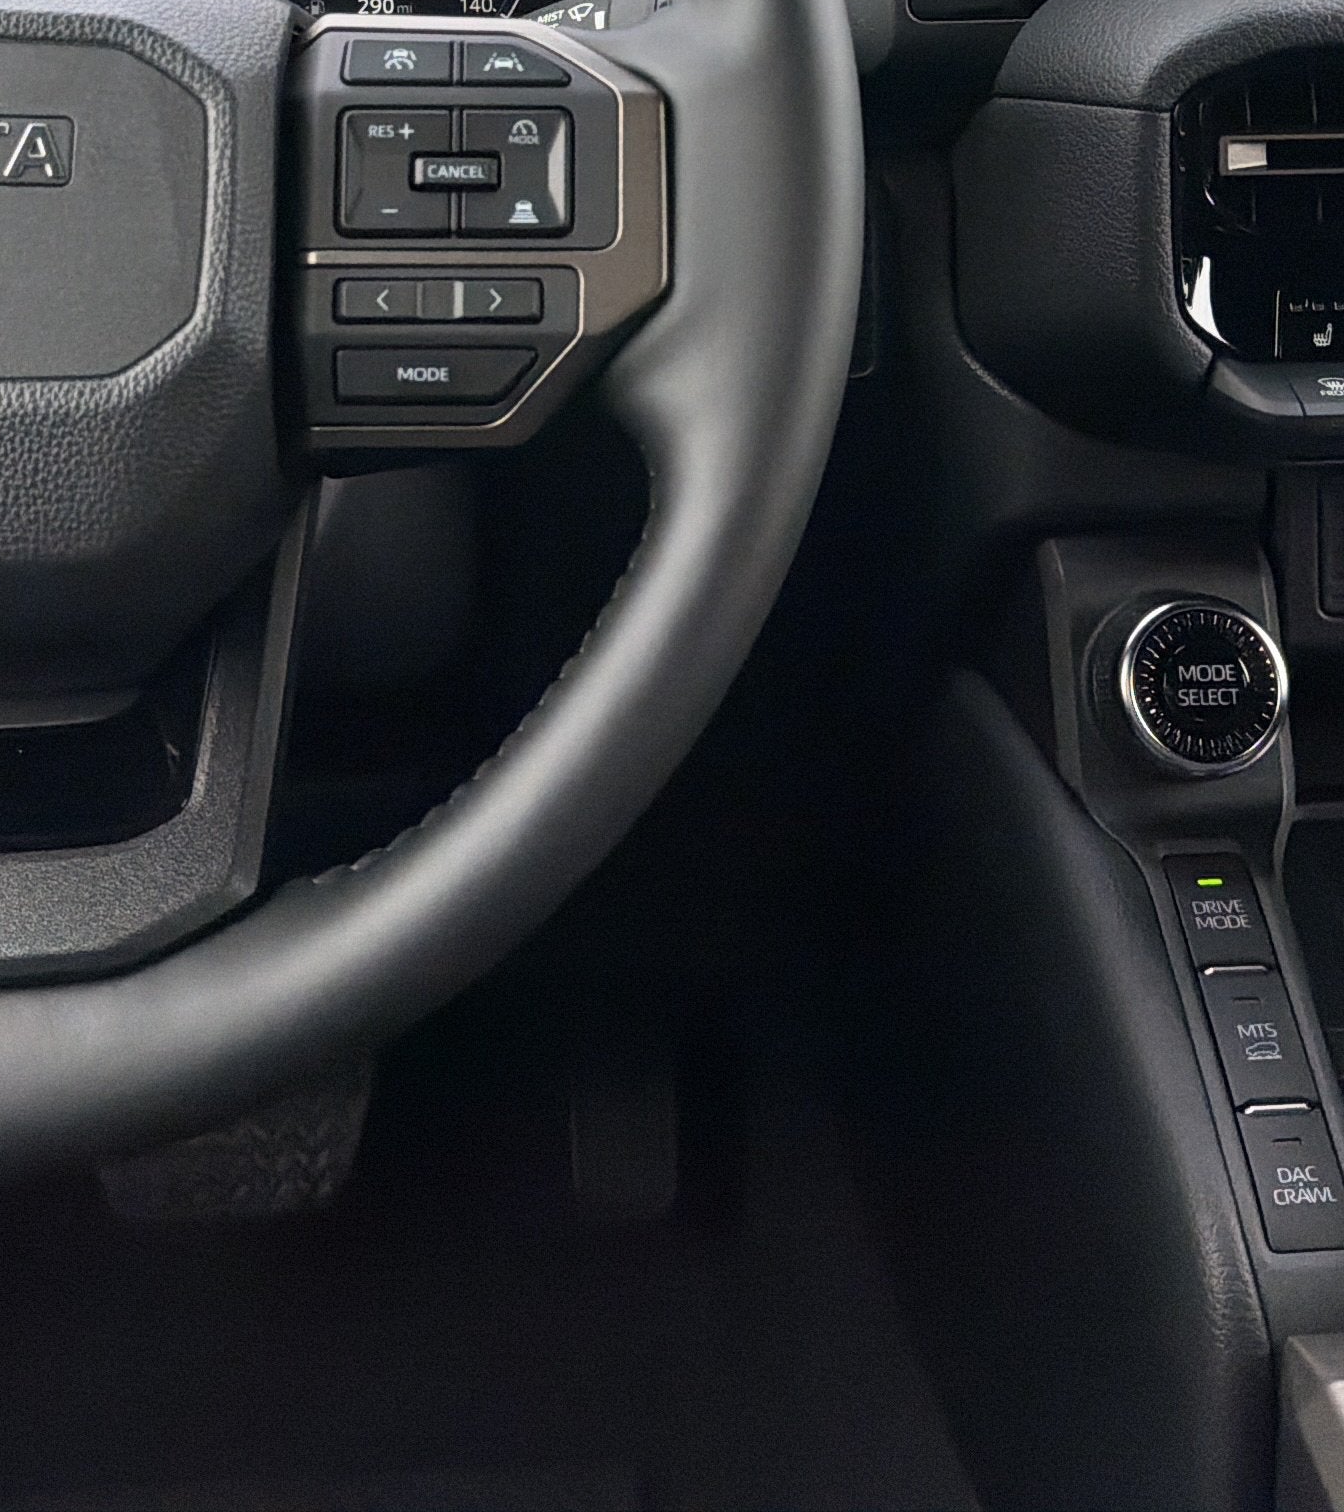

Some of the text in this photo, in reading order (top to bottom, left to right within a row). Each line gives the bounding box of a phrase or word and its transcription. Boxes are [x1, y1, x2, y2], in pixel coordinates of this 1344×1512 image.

[397, 3, 413, 13] mi
[537, 10, 565, 24] MIST
[508, 134, 540, 144] MODE
[428, 165, 485, 179] CANCEL
[397, 368, 449, 382] MODE
[1179, 665, 1236, 682] MODE
[1178, 688, 1239, 706] SELECT
[1192, 900, 1245, 914] DRIVE
[1195, 915, 1251, 930] MODE
[1237, 1023, 1277, 1038] MTS
[1277, 1165, 1318, 1183] DAC
[1274, 1188, 1337, 1205] CRAWL
